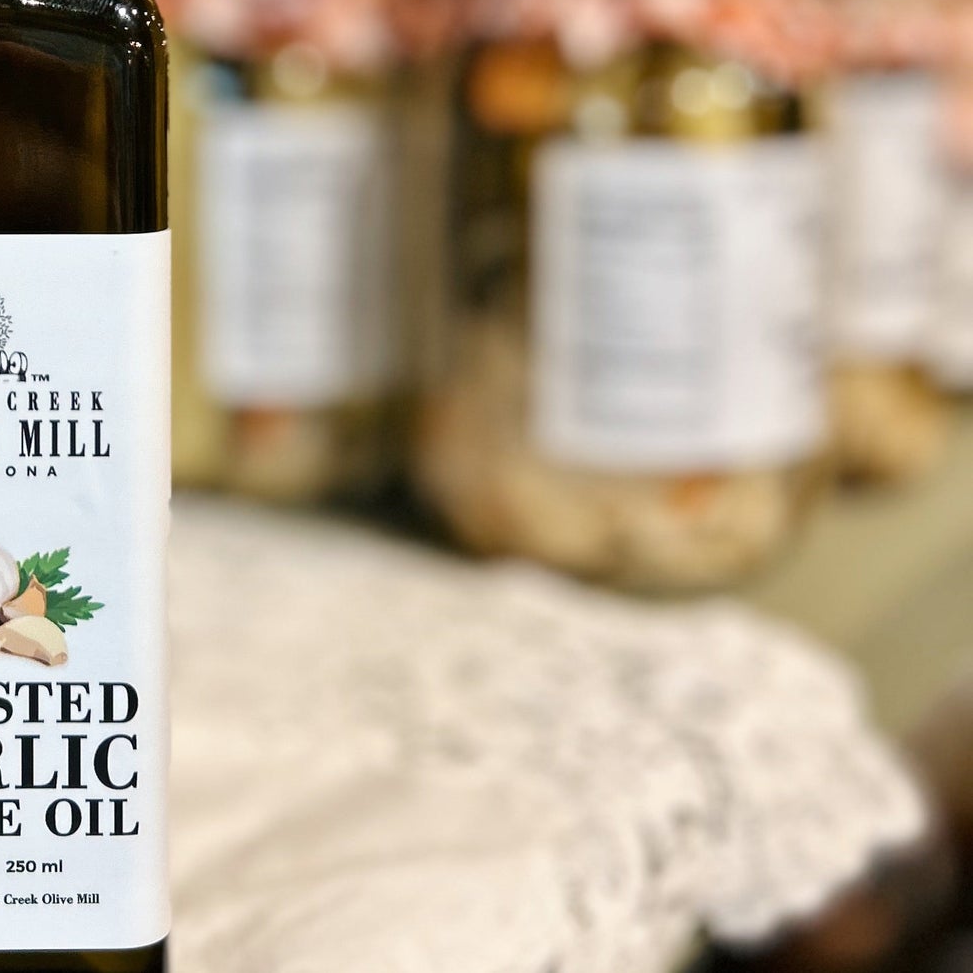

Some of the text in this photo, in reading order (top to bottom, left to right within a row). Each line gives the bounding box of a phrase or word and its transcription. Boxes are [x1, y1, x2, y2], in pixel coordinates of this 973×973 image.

[7, 391, 103, 411] CREEK
[19, 420, 110, 457] MILL
[45, 798, 139, 836] OIL
[5, 859, 37, 874] 250
[41, 859, 63, 873] ml
[3, 893, 39, 905] Creek
[41, 892, 74, 905] Olive
[76, 893, 100, 905] Mill
